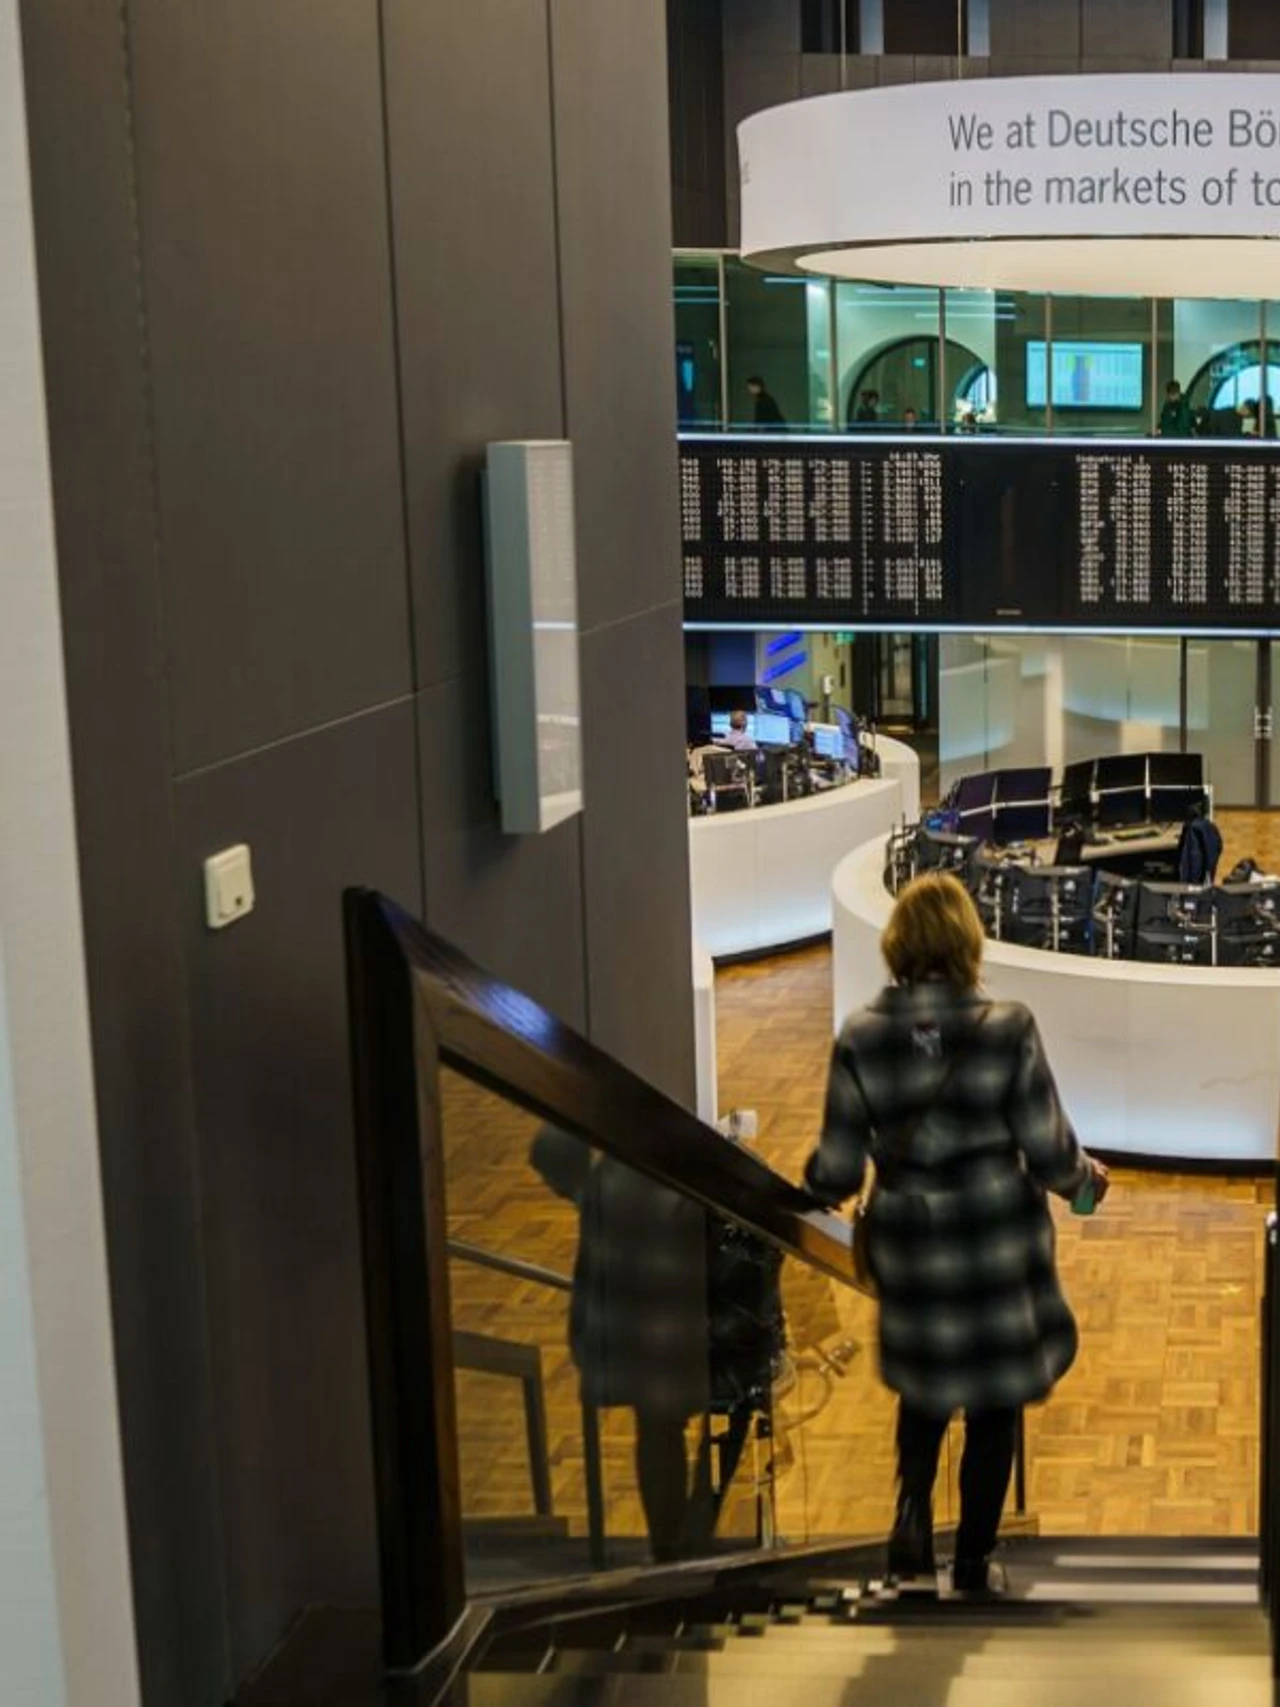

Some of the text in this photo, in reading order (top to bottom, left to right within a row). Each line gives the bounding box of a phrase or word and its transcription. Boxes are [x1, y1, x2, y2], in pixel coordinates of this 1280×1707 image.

[947, 113, 994, 152] We
[1005, 113, 1037, 150] at
[1047, 108, 1214, 149] Deutsche
[949, 170, 973, 207] in
[983, 169, 1033, 207] the
[1044, 166, 1187, 206] markets
[1201, 167, 1239, 207] of
